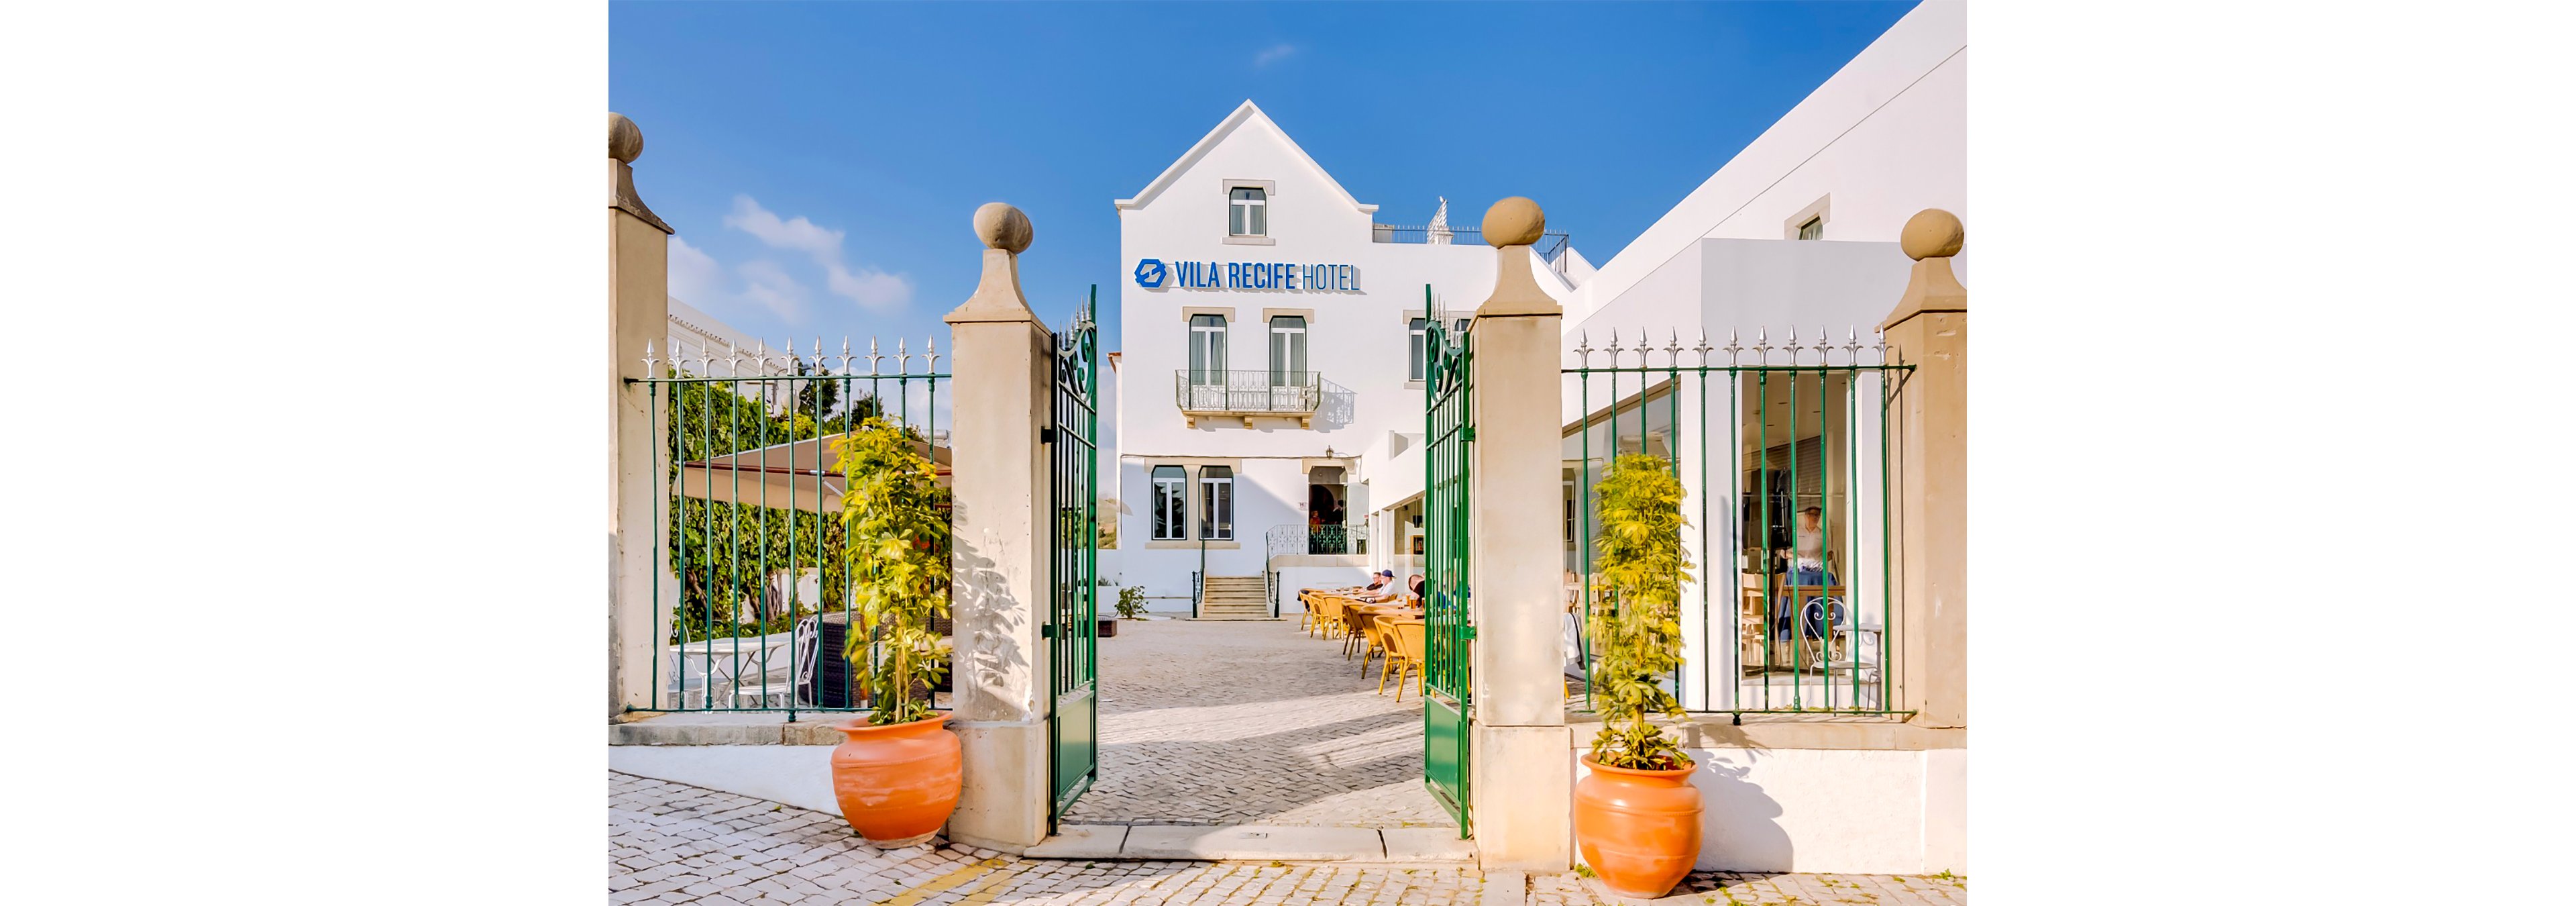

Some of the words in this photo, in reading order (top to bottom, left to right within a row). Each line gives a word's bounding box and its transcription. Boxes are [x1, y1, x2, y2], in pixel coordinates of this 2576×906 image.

[1175, 261, 1220, 287] VILA
[1228, 262, 1295, 289] RECIFE
[1303, 264, 1360, 291] HOTEL
